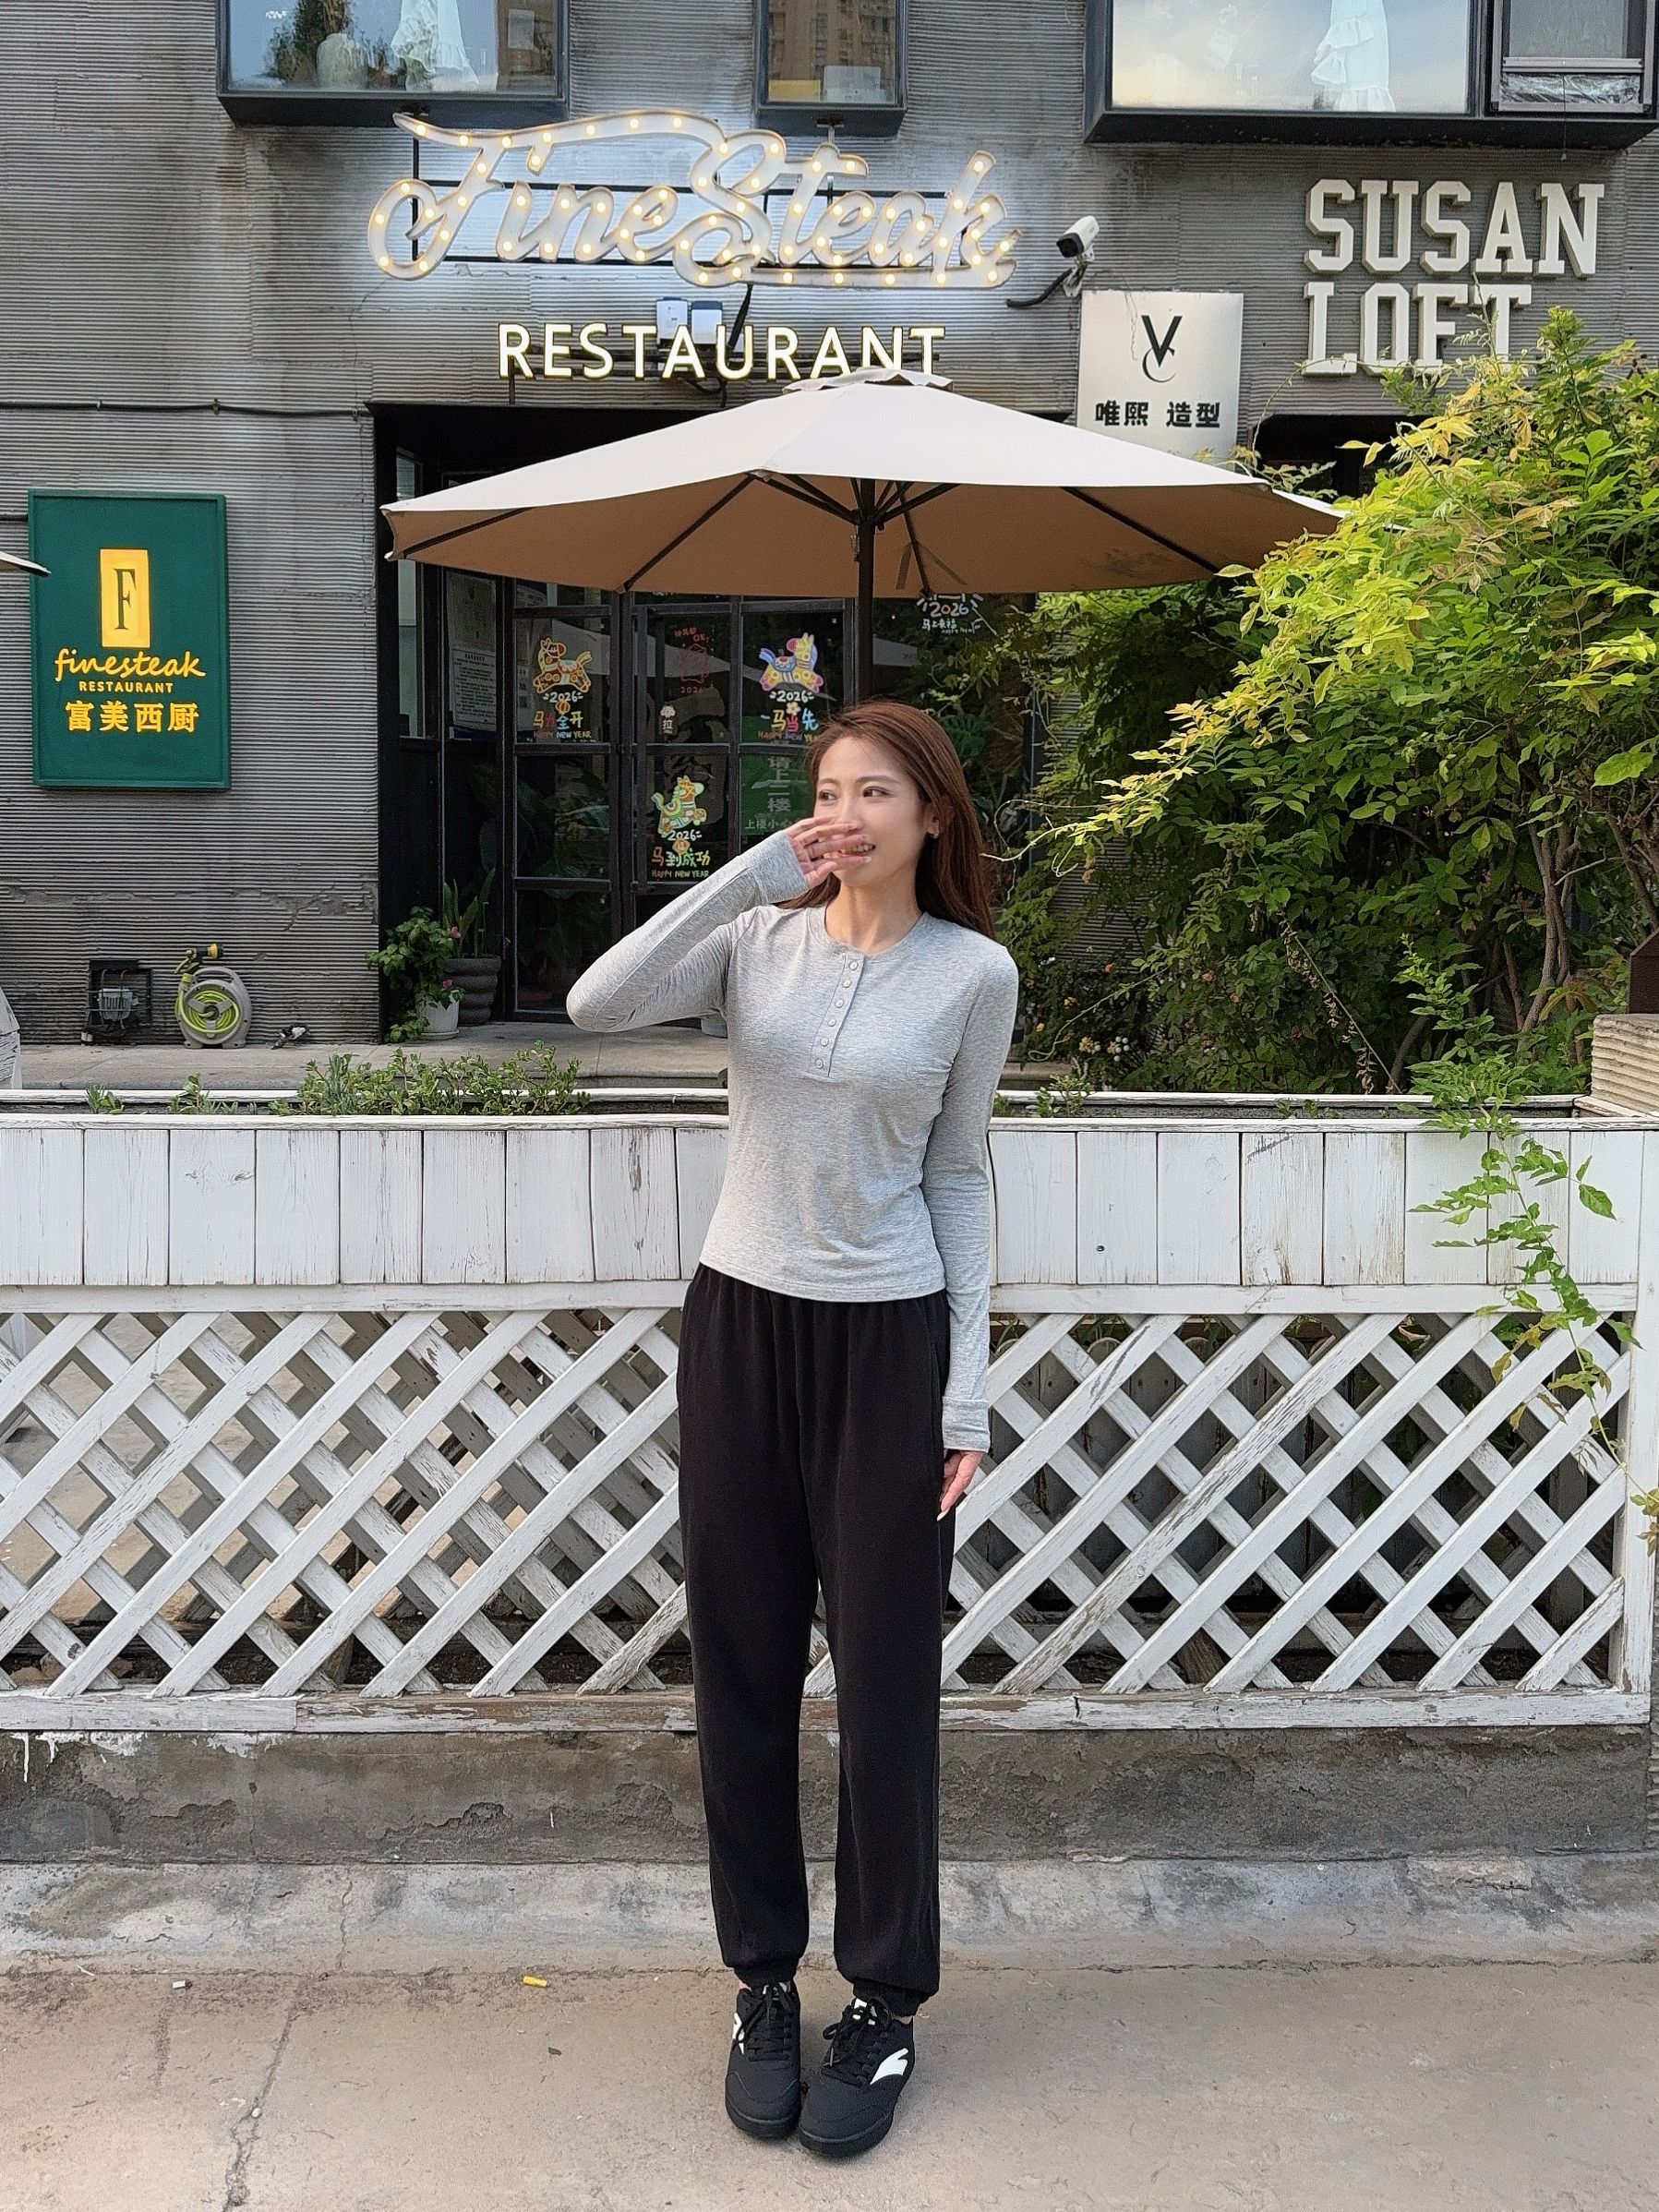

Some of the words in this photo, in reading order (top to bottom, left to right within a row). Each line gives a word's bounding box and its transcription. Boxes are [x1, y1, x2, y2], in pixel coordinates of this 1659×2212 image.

[1303, 178, 1605, 278] SUSAN
[1303, 281, 1532, 377] LOFT
[498, 323, 946, 380] RESTAURANT
[1095, 400, 1148, 427] 唯熙
[1166, 401, 1220, 428] 造型
[113, 568, 137, 631] F
[929, 601, 969, 618] 2026
[54, 648, 206, 682] finesteak
[79, 680, 174, 693] RESTAURANT
[549, 691, 578, 703] 2026
[776, 690, 809, 703] 2026
[66, 700, 199, 733] 富美西厨
[663, 719, 674, 729] 拉
[760, 707, 819, 732] 一马当先
[573, 730, 591, 739] YEAR
[667, 829, 697, 841] 2026
[652, 847, 711, 868] 马到成功
[652, 870, 672, 878] HAPPY
